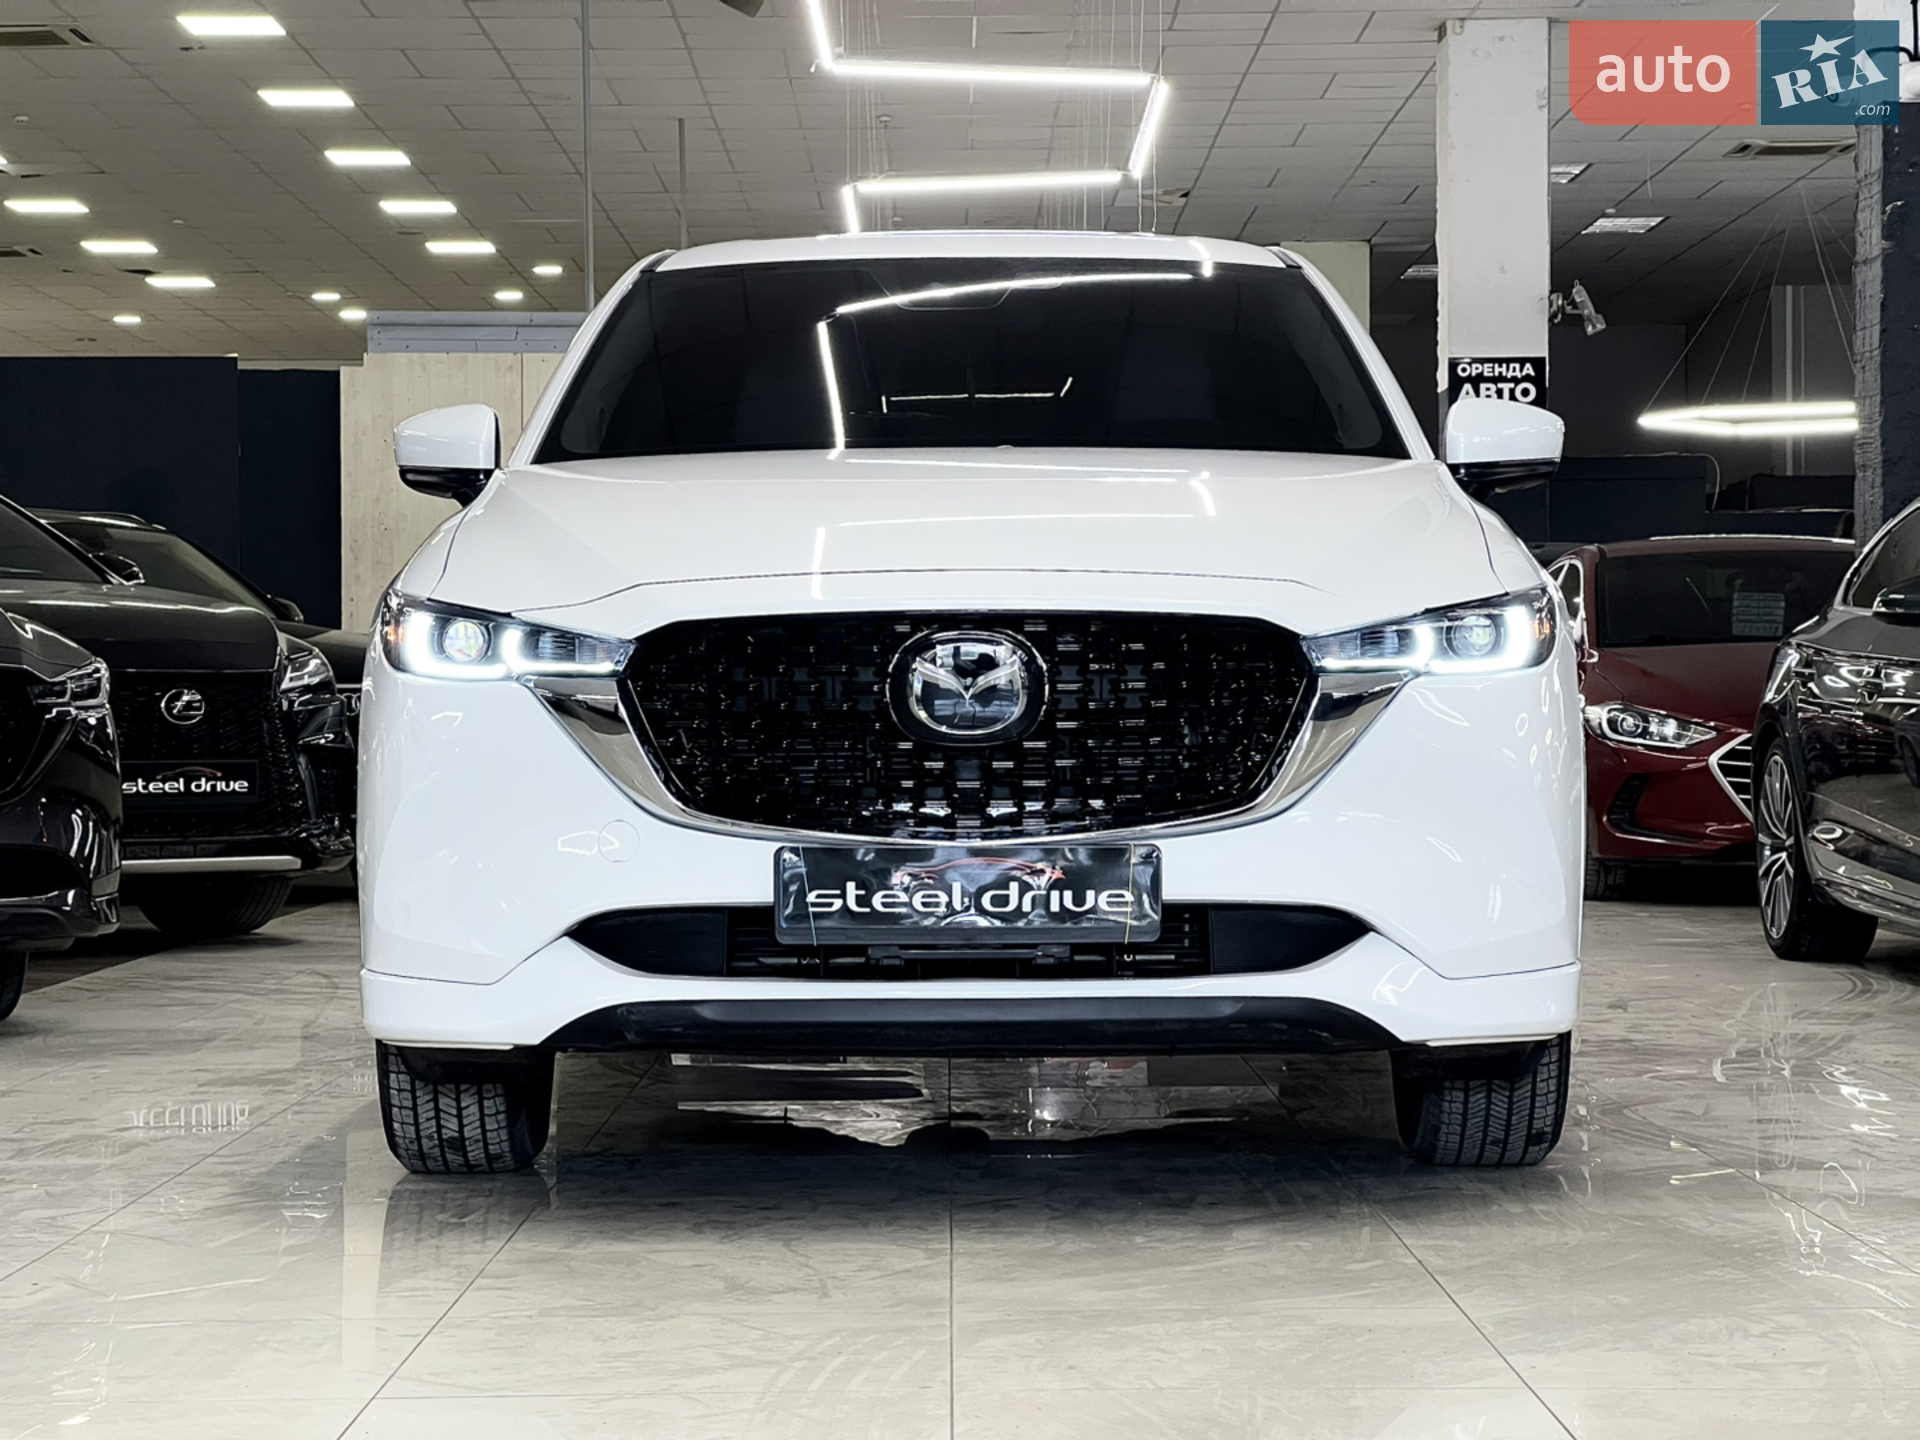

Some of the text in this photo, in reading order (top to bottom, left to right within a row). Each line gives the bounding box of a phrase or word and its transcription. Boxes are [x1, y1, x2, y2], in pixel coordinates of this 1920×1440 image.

[1456, 362, 1536, 379] ОРЕНДА
[1457, 382, 1537, 403] АВТО
[121, 776, 249, 794] steel drive
[806, 880, 1134, 913] steel drive
